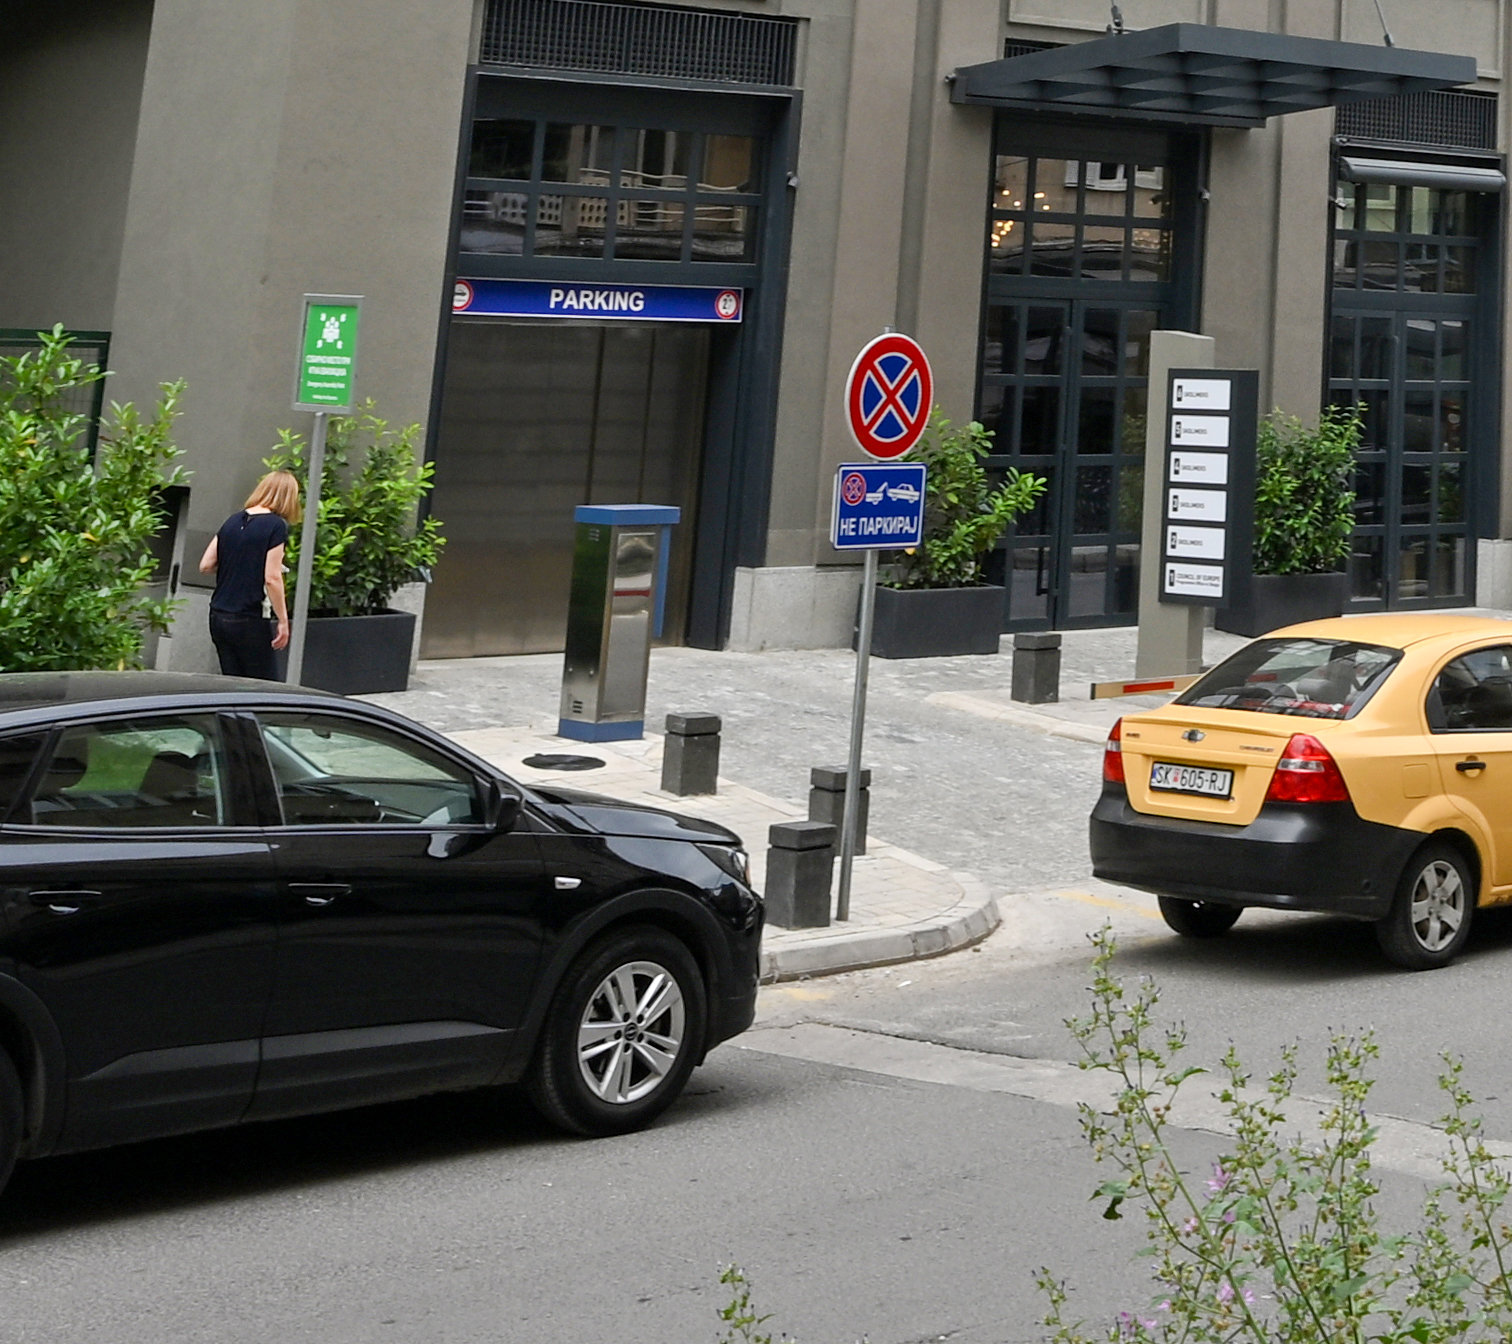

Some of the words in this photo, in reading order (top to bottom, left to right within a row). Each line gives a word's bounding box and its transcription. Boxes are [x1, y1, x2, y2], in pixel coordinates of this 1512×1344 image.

[549, 288, 645, 312] PARKING
[840, 518, 857, 536] НЕ
[858, 515, 918, 536] ПАРКИРАЈ
[1155, 766, 1172, 784] SK
[1180, 768, 1227, 791] 605-RJ
